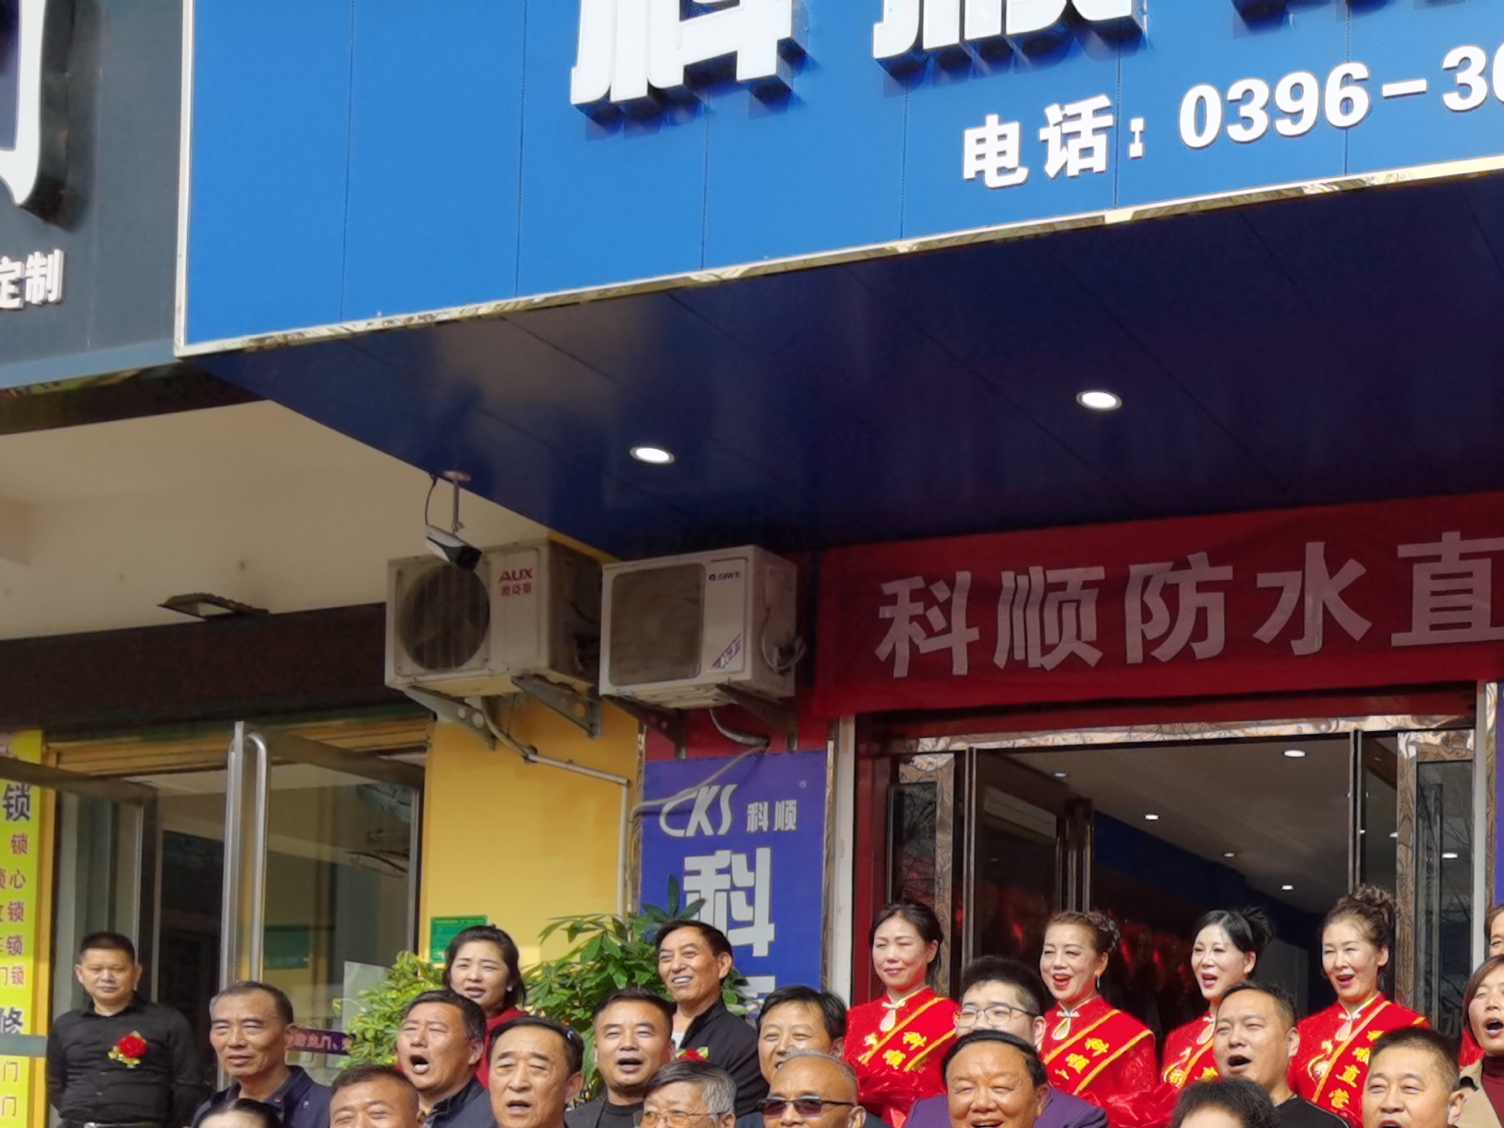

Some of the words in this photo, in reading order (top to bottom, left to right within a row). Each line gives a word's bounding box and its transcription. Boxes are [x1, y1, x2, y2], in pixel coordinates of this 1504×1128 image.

[498, 568, 533, 583] AUX
[659, 784, 738, 838] CKS
[746, 799, 798, 832] 科顺
[0, 901, 25, 923] 锁
[683, 847, 777, 1002] 科
